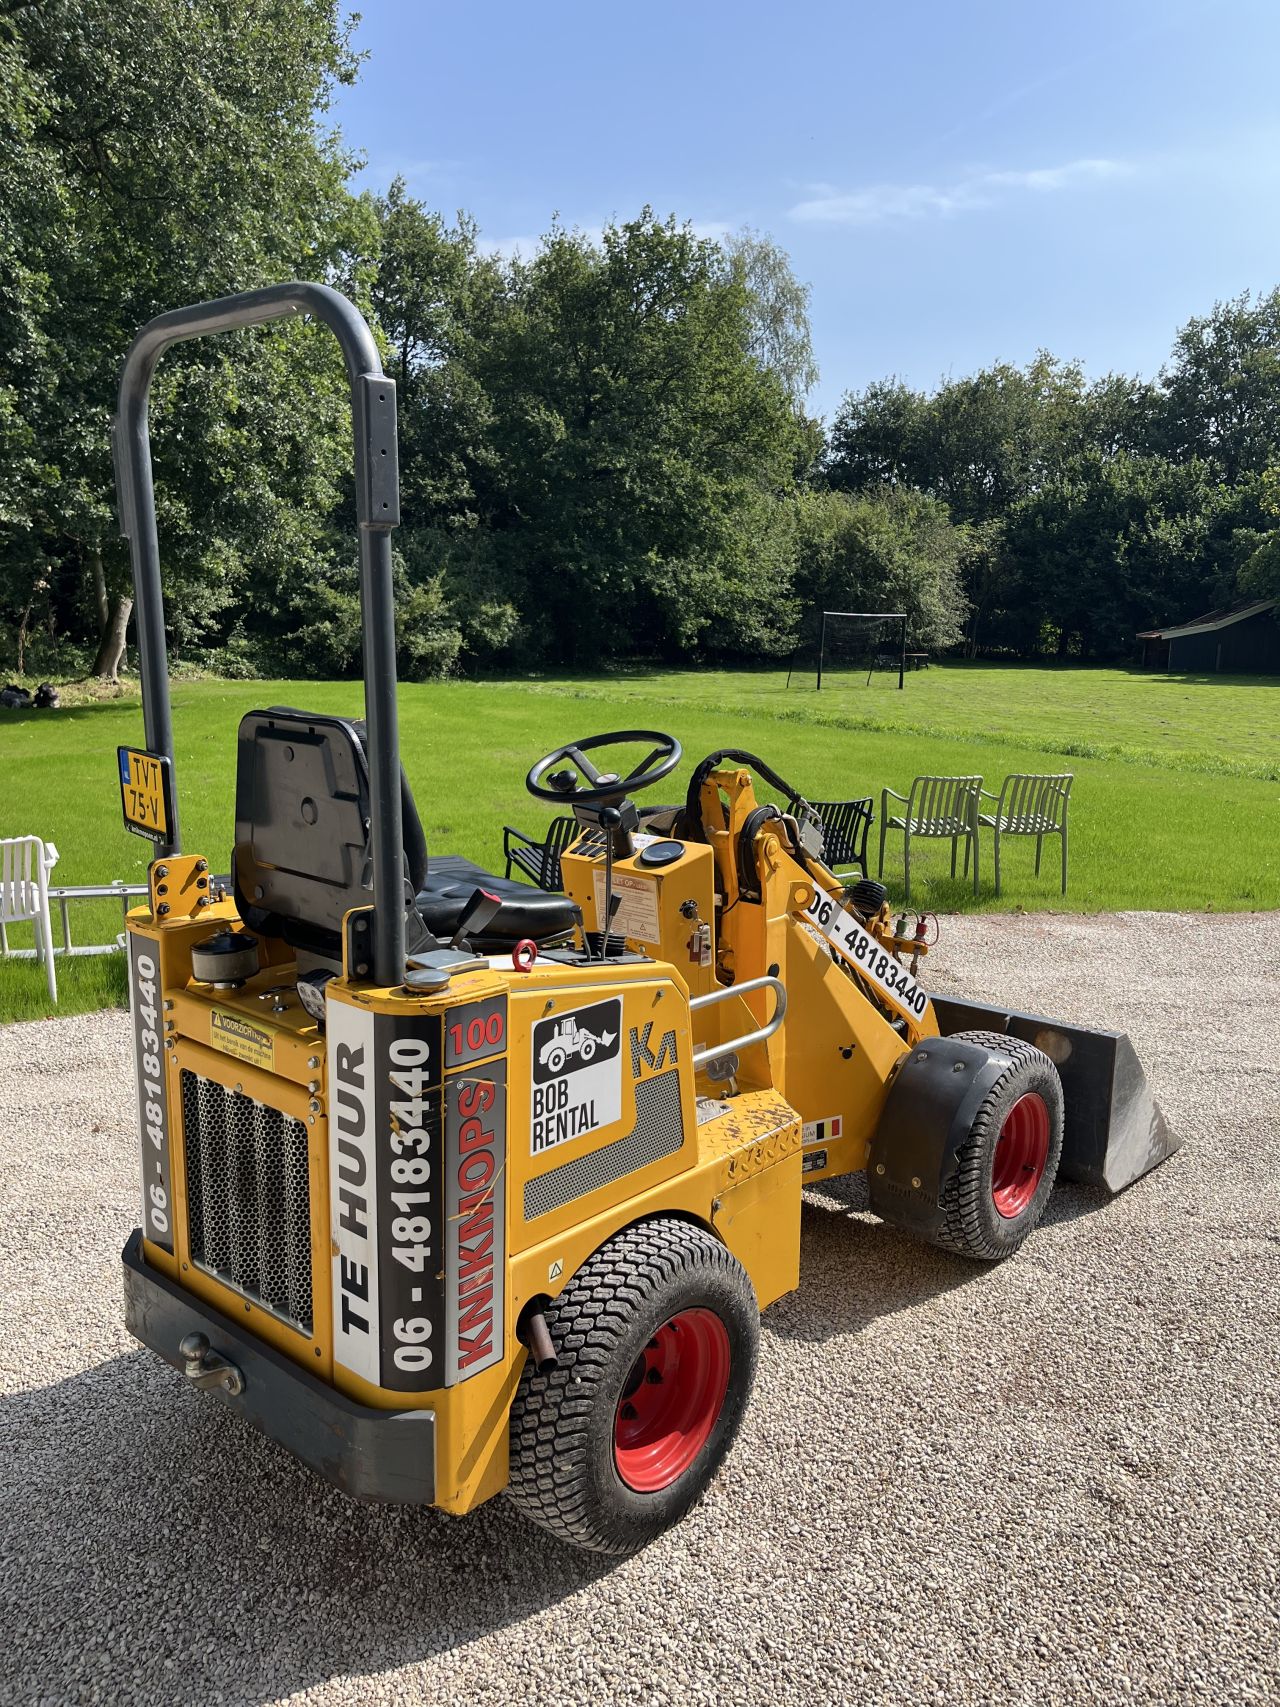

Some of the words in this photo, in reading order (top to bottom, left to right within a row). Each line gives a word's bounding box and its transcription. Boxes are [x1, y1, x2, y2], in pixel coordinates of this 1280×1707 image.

[133, 757, 158, 791] TVT
[129, 789, 158, 825] 75-V
[808, 891, 833, 926] 06
[845, 928, 926, 1014] 48183440
[137, 953, 165, 1151] 48183440
[449, 1012, 504, 1055] 100
[533, 1078, 569, 1120] BOB
[533, 1099, 600, 1153] RENTAL
[336, 1040, 370, 1240] HUUR
[388, 1037, 433, 1274] 48183440
[150, 1186, 169, 1234] 06
[457, 1075, 496, 1372] KNIKMOPS
[340, 1253, 371, 1338] TE
[393, 1315, 433, 1373] 06
